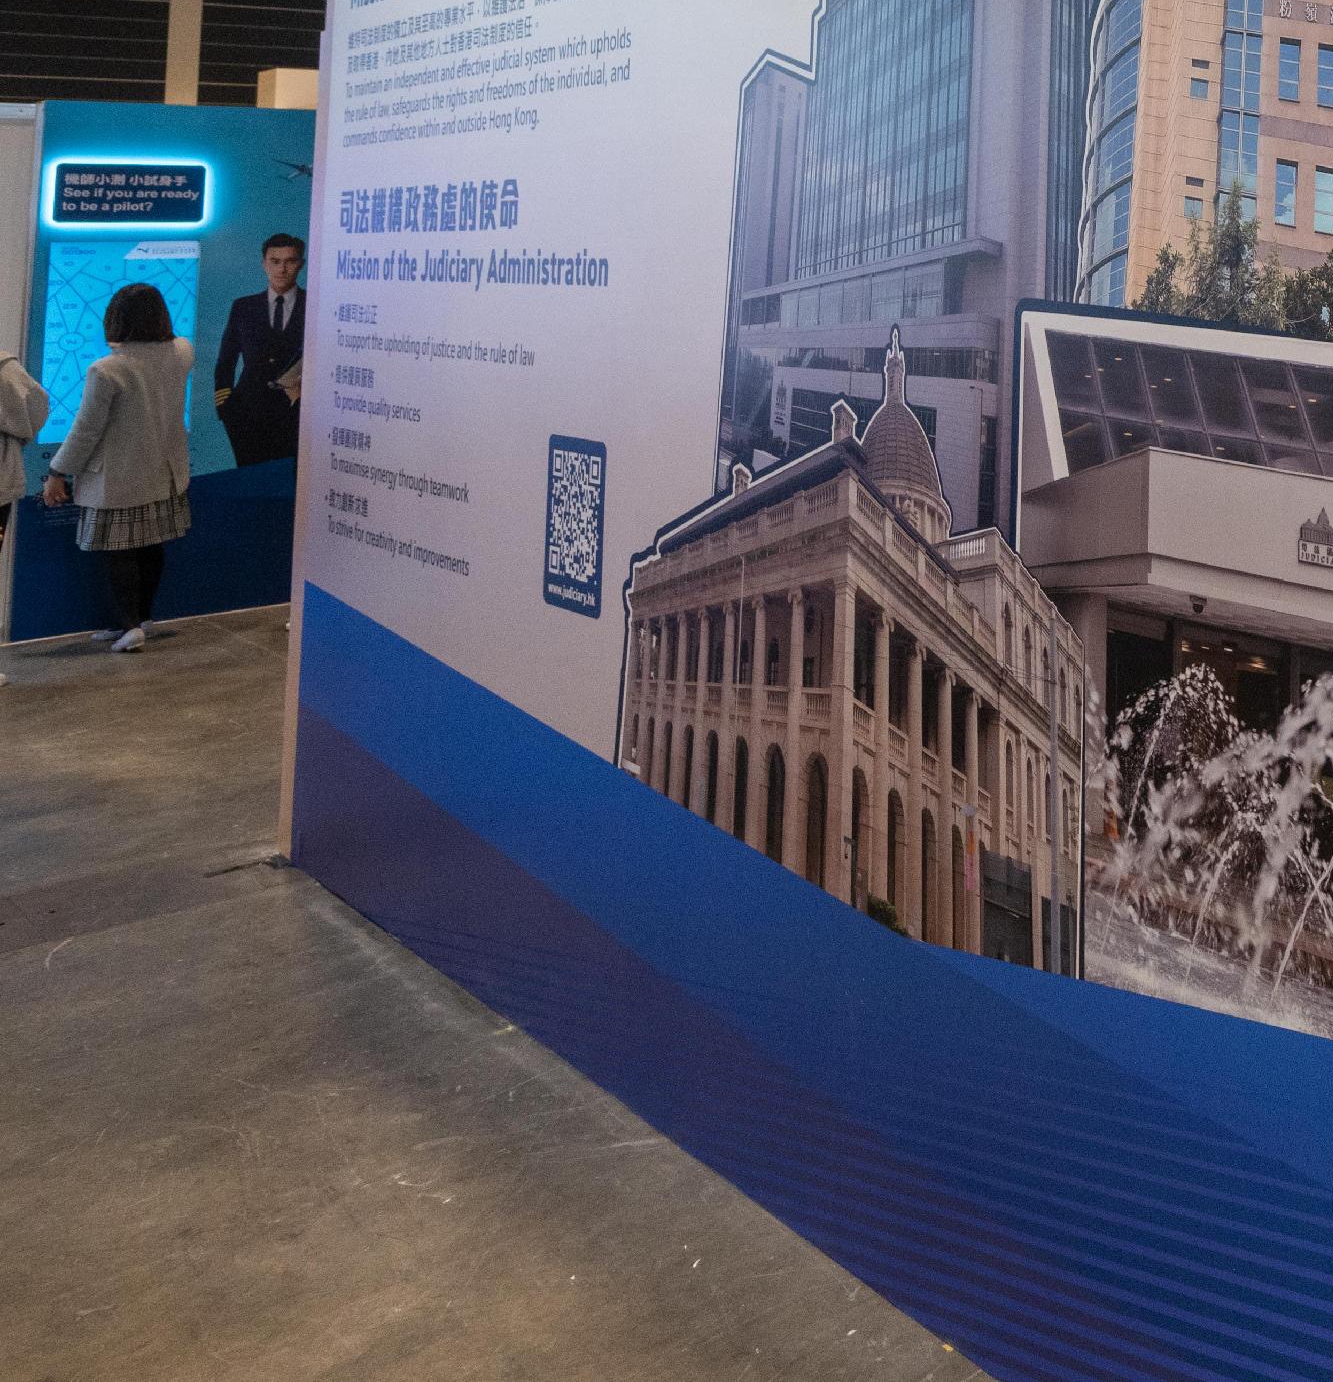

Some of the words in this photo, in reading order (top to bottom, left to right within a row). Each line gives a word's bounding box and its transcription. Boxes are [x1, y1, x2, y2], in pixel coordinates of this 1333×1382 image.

[393, 66, 441, 91] independent
[441, 64, 456, 83] and
[456, 56, 491, 81] effective
[492, 49, 524, 79] judicial
[524, 45, 556, 71] system
[558, 38, 588, 61] which
[590, 26, 632, 61] upholds
[344, 106, 355, 123] the
[355, 102, 369, 122] rule
[392, 92, 431, 118] safeguards
[432, 92, 445, 110] the
[446, 87, 468, 114] rights
[468, 85, 485, 104] and
[485, 79, 527, 102] freedoms
[528, 74, 541, 96] of
[541, 72, 556, 93] the
[557, 61, 608, 91] individual,
[610, 57, 631, 84] and
[343, 123, 379, 148] commands
[379, 118, 417, 143] confidence
[417, 114, 441, 138] within
[441, 116, 457, 136] and
[457, 111, 487, 134] outside
[488, 111, 513, 133] Hong
[514, 107, 540, 131] Kong.
[62, 201, 77, 211] to
[79, 200, 98, 211] be
[101, 201, 110, 211] a
[113, 200, 154, 213] pilot?
[63, 187, 92, 198] See
[93, 187, 104, 198] if
[106, 189, 134, 201] you
[136, 189, 159, 199] are
[161, 188, 200, 201] ready
[340, 178, 520, 234] 司法機構政務處的使命
[337, 250, 380, 280] Mission
[383, 250, 395, 280] of
[398, 250, 417, 282] the
[421, 249, 484, 292] Judiciary
[487, 248, 609, 287] Administration
[345, 334, 371, 353] support
[371, 331, 384, 350] the
[384, 333, 421, 360] upholding
[421, 336, 431, 356] of
[430, 337, 456, 361] justice
[457, 341, 473, 360] and
[474, 341, 488, 362] the
[489, 343, 507, 364] rule
[508, 343, 519, 366] of
[520, 346, 536, 366] law
[342, 393, 367, 414] provide
[368, 398, 391, 422] quality
[392, 402, 421, 423] services
[338, 456, 370, 480] maximise
[370, 466, 398, 491] synergy
[399, 469, 429, 498] through
[430, 476, 470, 503] teamwork
[335, 520, 354, 539] strive
[354, 522, 365, 543] for
[365, 528, 398, 558] creativity
[398, 538, 412, 559] and
[413, 540, 470, 577] improvements
